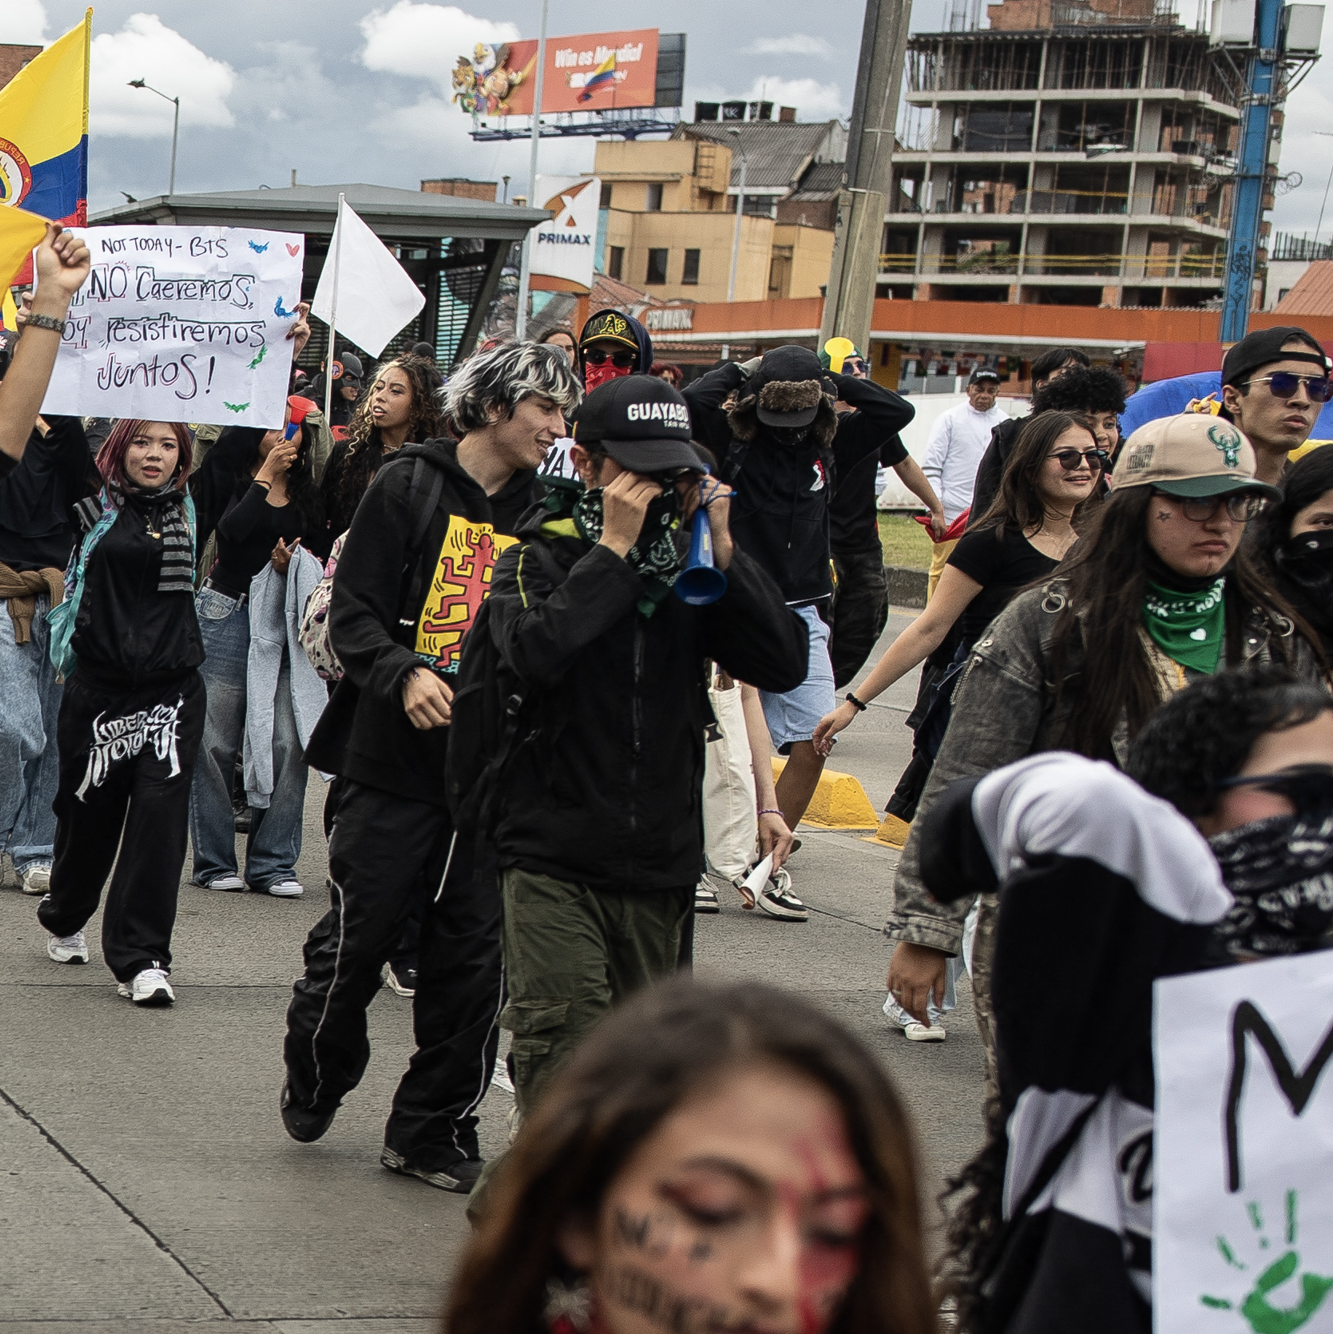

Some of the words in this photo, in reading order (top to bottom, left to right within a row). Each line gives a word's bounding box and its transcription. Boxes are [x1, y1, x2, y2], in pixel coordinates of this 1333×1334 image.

[101, 237, 127, 253] NOT
[189, 236, 230, 258] BTS
[537, 232, 591, 246] PRIMAX
[627, 403, 690, 423] GUAYABO
